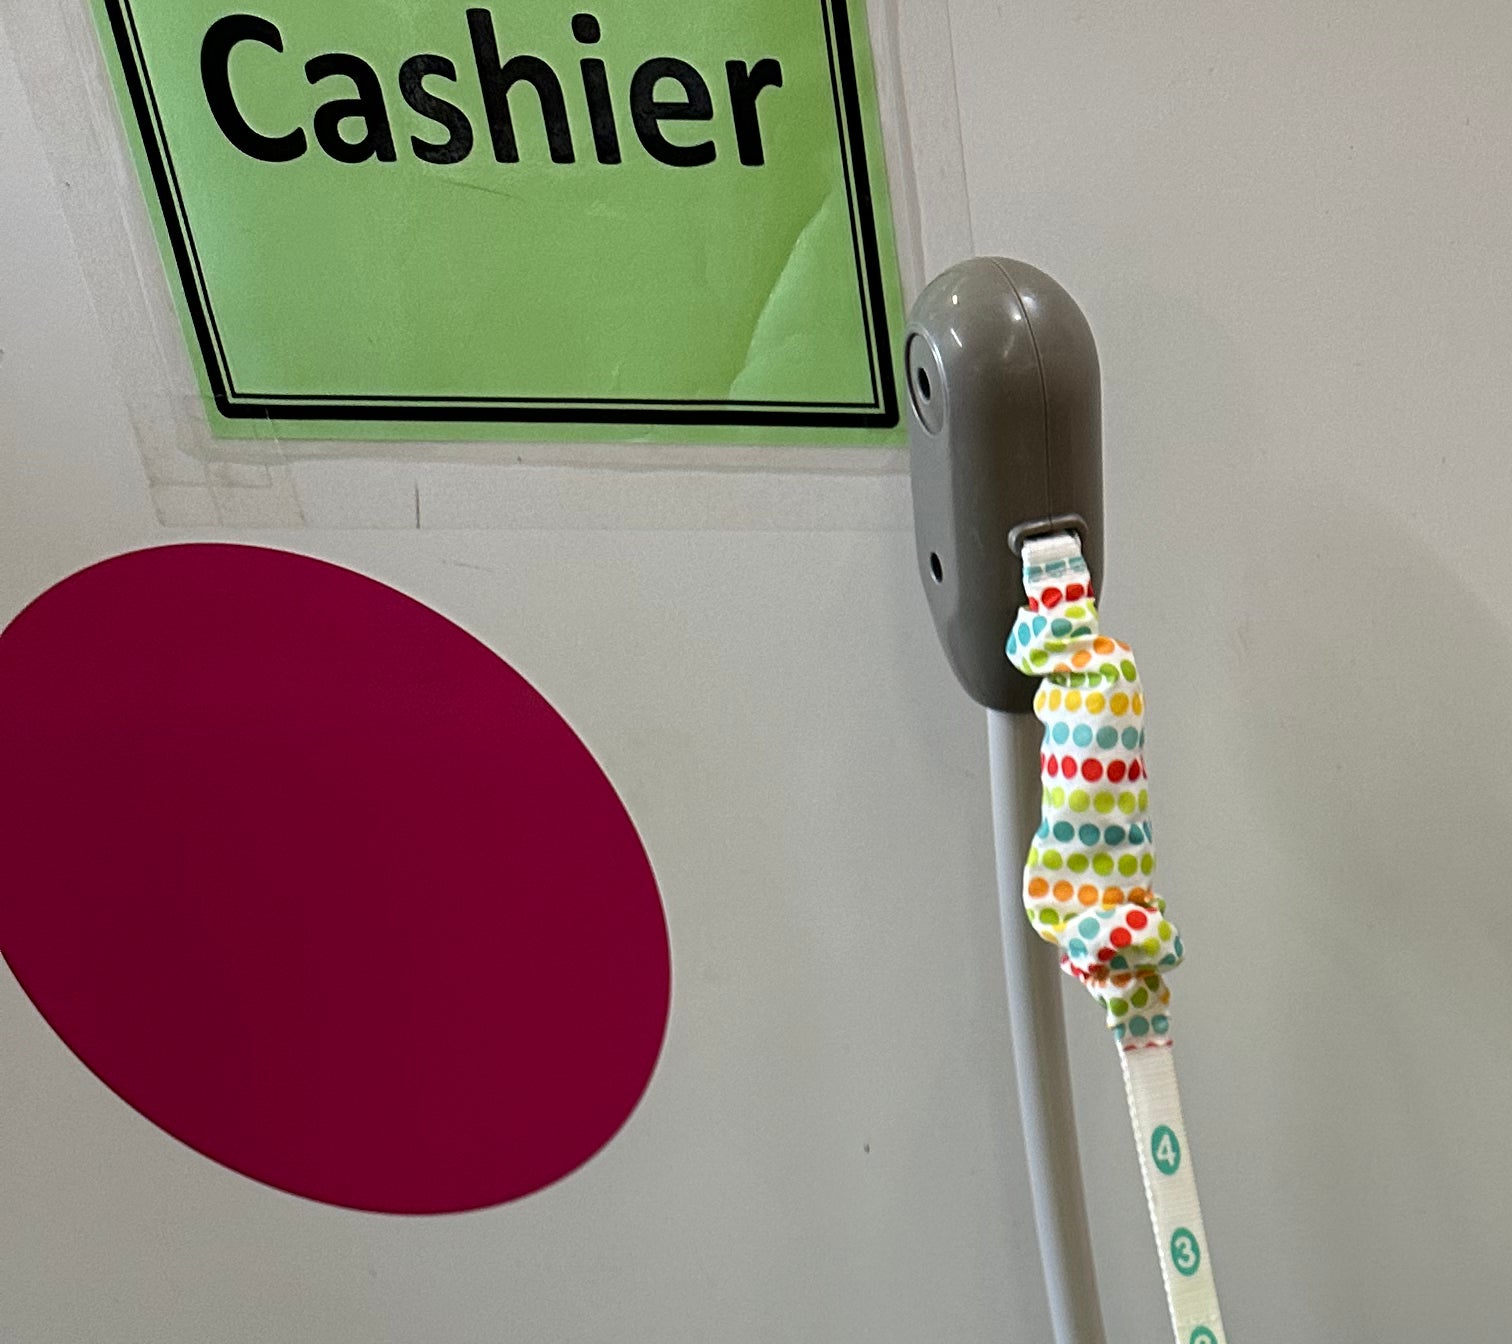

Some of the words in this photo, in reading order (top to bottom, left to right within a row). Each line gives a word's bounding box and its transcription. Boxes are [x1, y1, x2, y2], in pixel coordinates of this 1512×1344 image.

[201, 8, 783, 167] Cashier
[1154, 1132, 1178, 1168] 4
[1173, 1234, 1198, 1271] 3
